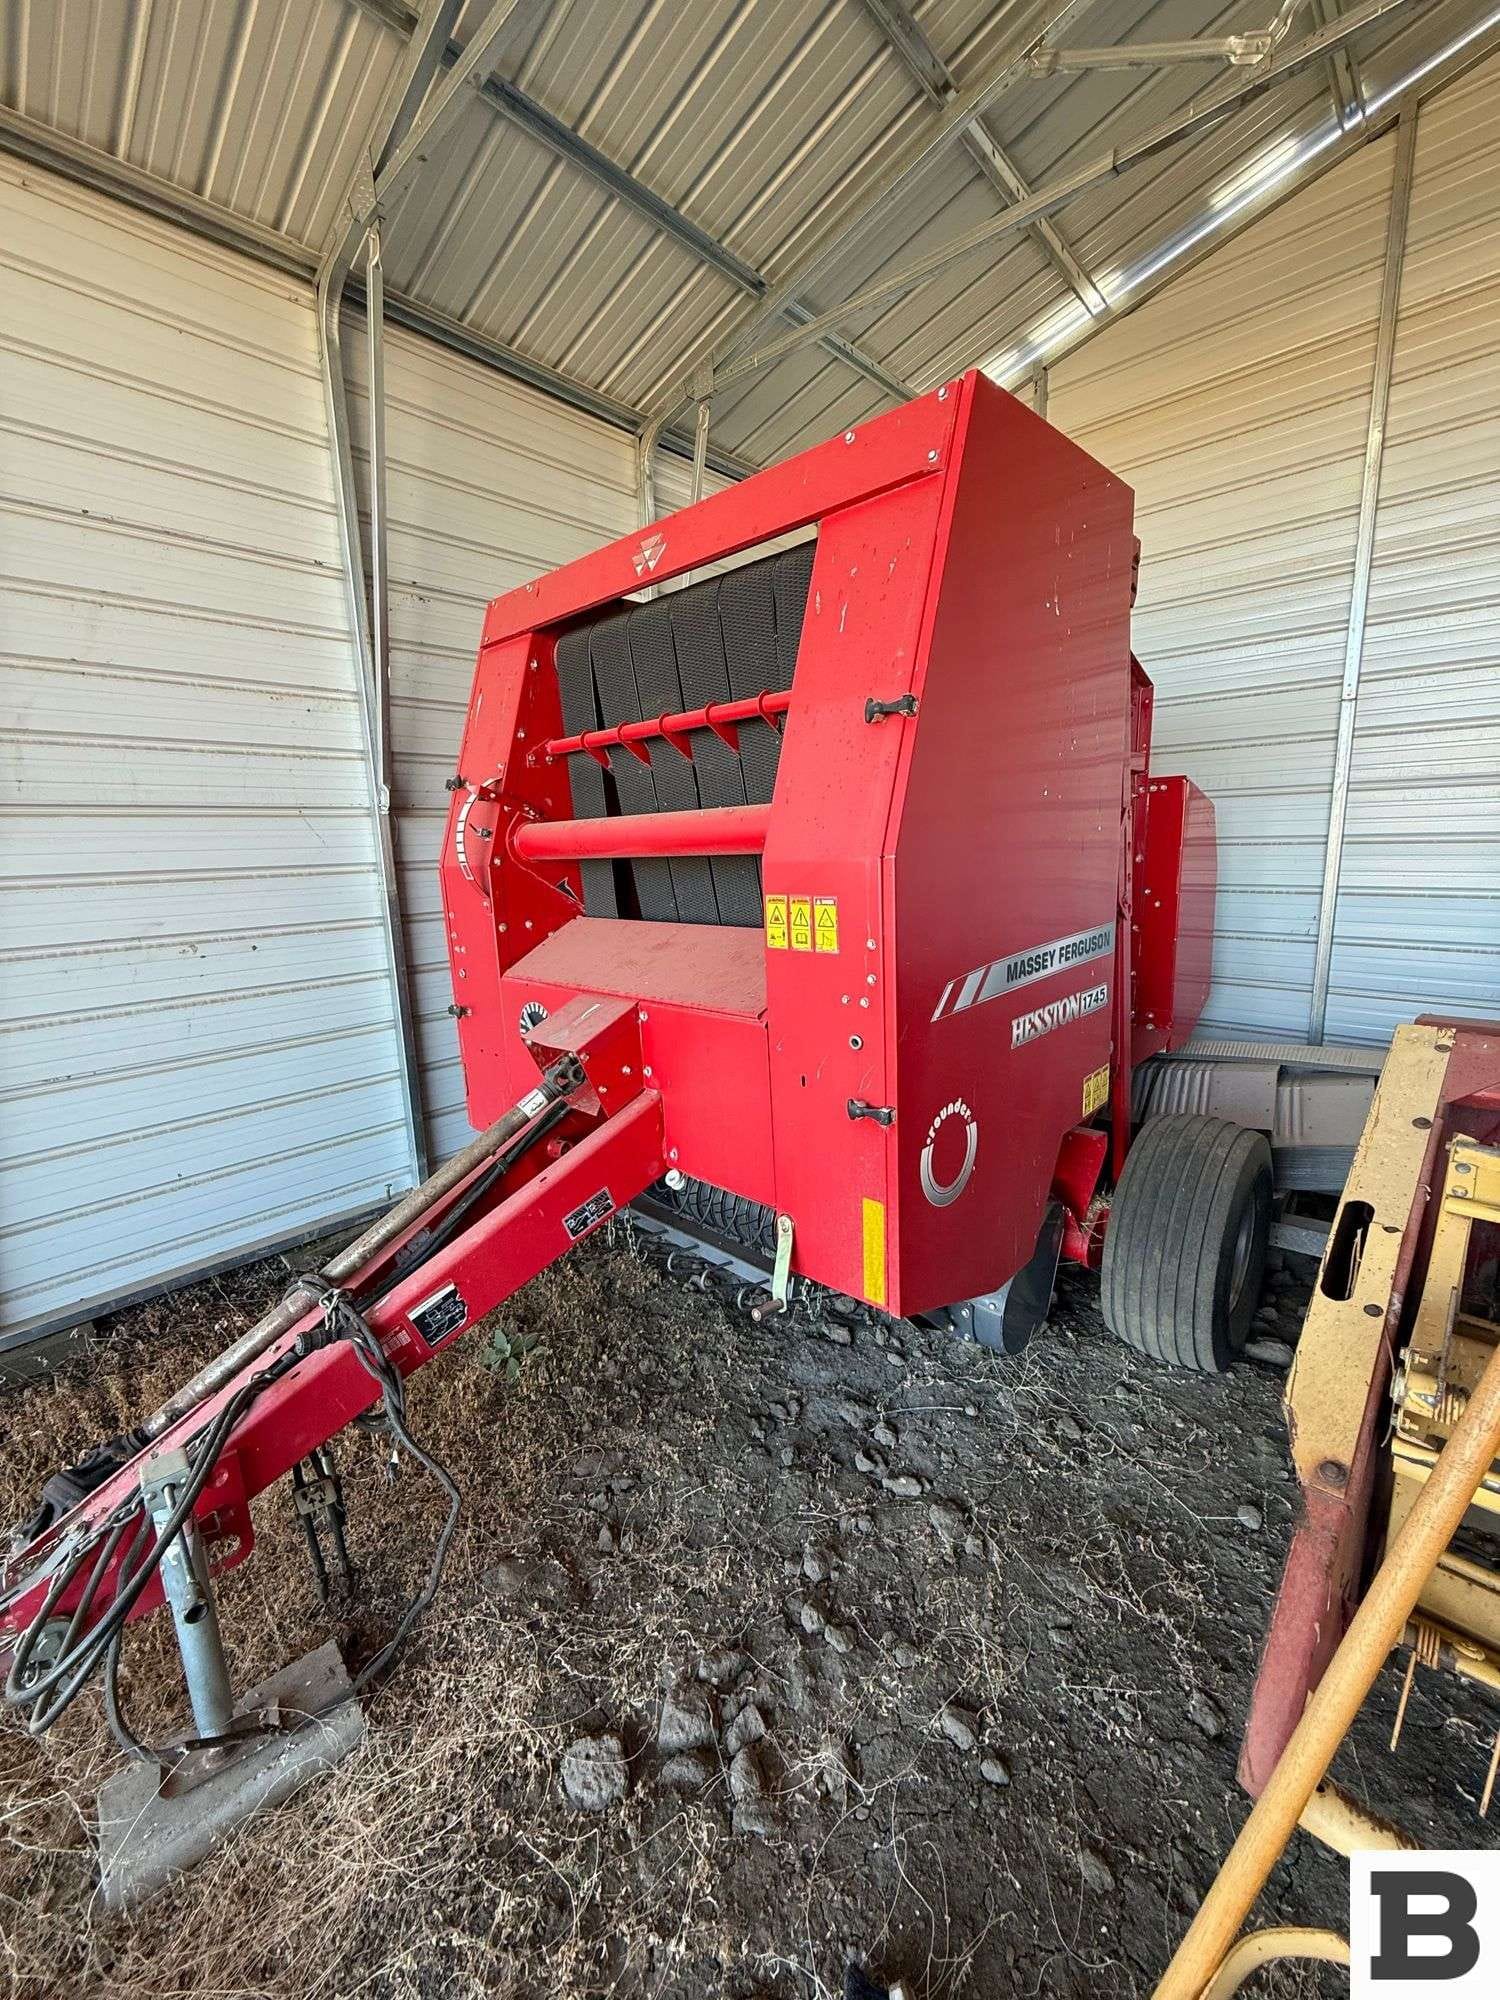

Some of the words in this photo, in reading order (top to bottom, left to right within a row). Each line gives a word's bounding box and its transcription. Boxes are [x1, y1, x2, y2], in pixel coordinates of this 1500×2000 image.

[1006, 949, 1057, 983] MASSEY
[1058, 931, 1111, 964] FERGUSON
[1011, 992, 1082, 1049] HESSTON
[1083, 990, 1106, 1010] 1745
